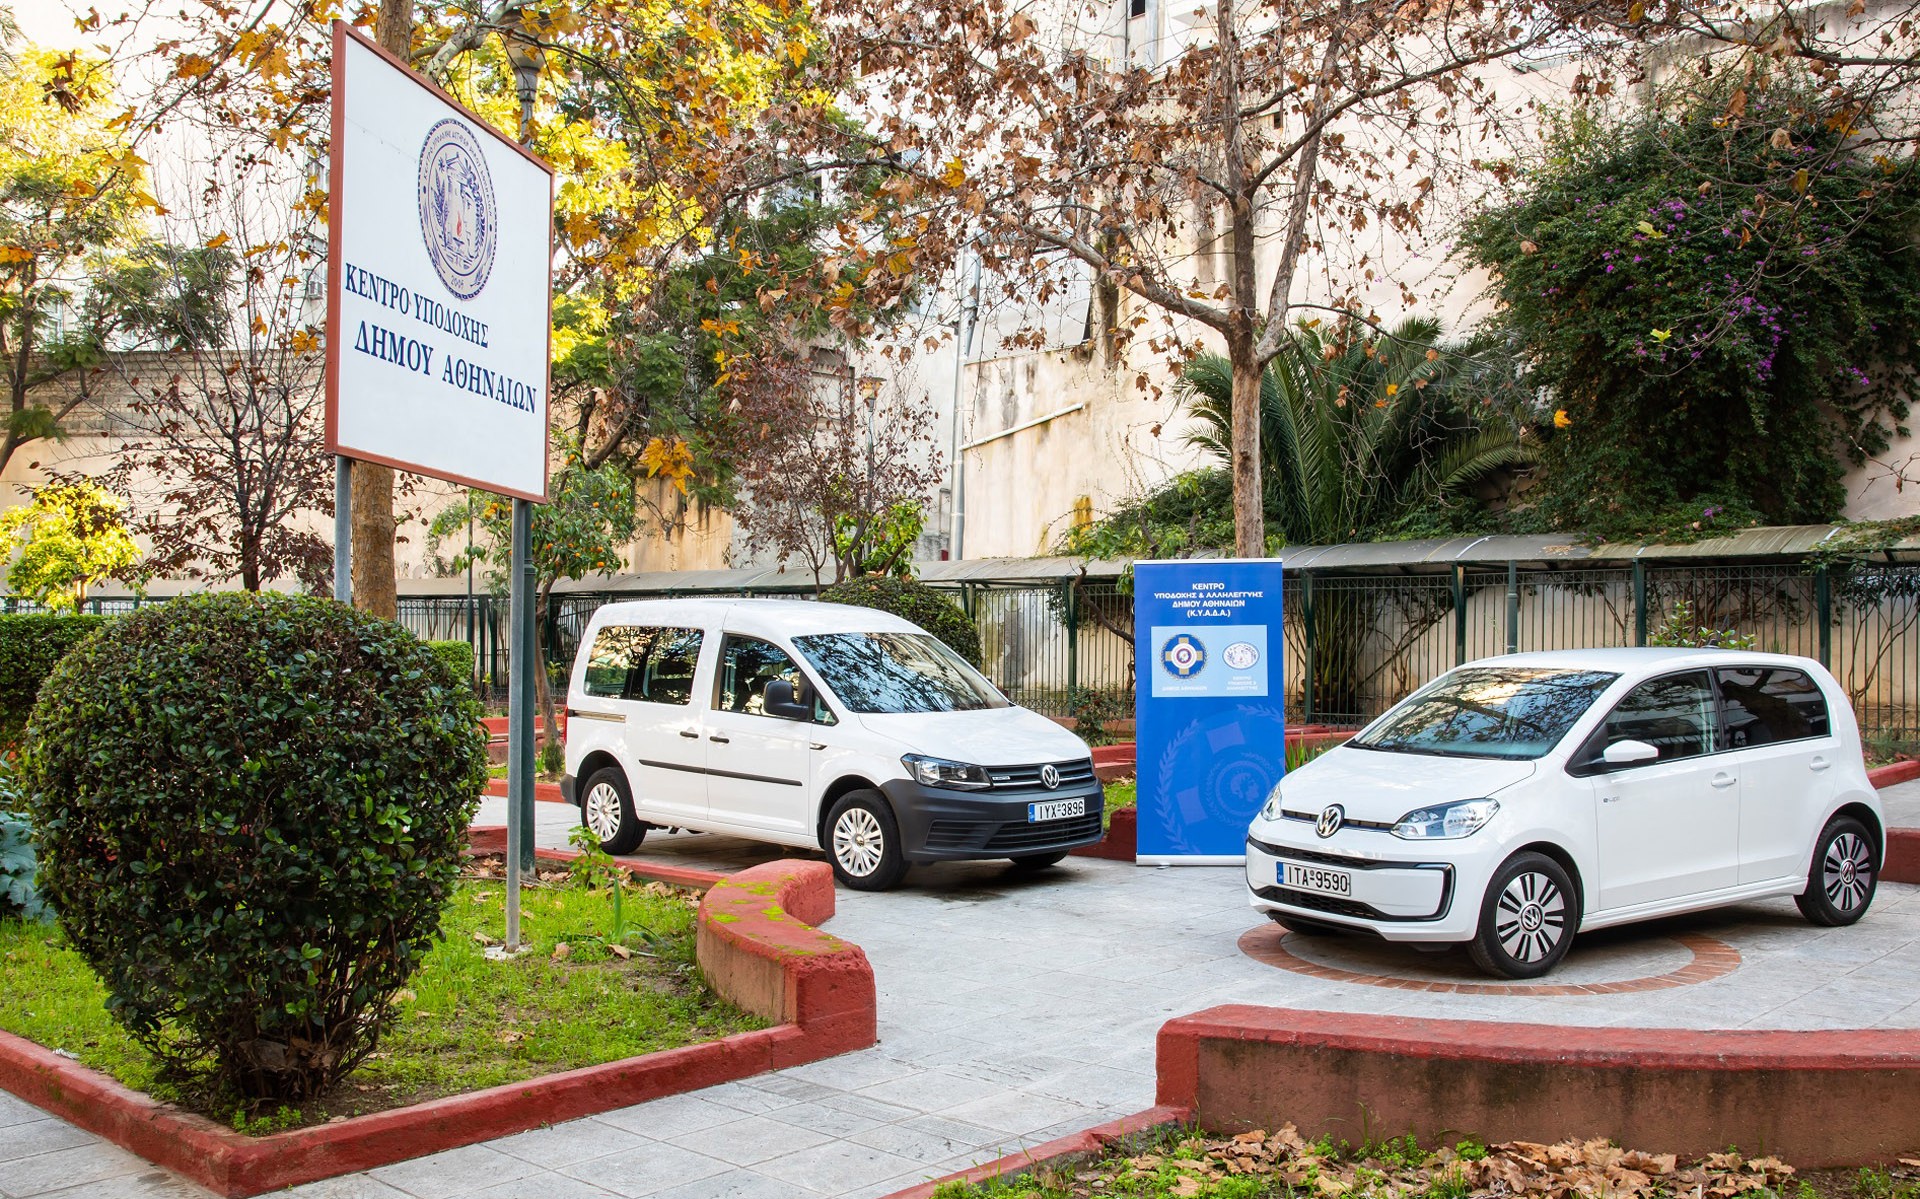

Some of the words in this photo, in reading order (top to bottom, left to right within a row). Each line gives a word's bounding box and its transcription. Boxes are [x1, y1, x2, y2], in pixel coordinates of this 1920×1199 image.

[345, 262, 410, 315] ΚΕΝΤΡΟ
[413, 292, 489, 349] ΥΠΟΔΟΧΗΣ
[354, 320, 434, 376] ΔΗΜΟΥ
[442, 354, 537, 414] ΑΘΗΝΑΙΩΝ
[1187, 609, 1231, 618] (Κ.Υ.Α.Δ.Α.)
[1202, 600, 1245, 608] ΑΘΗΝΑΙΩΝ
